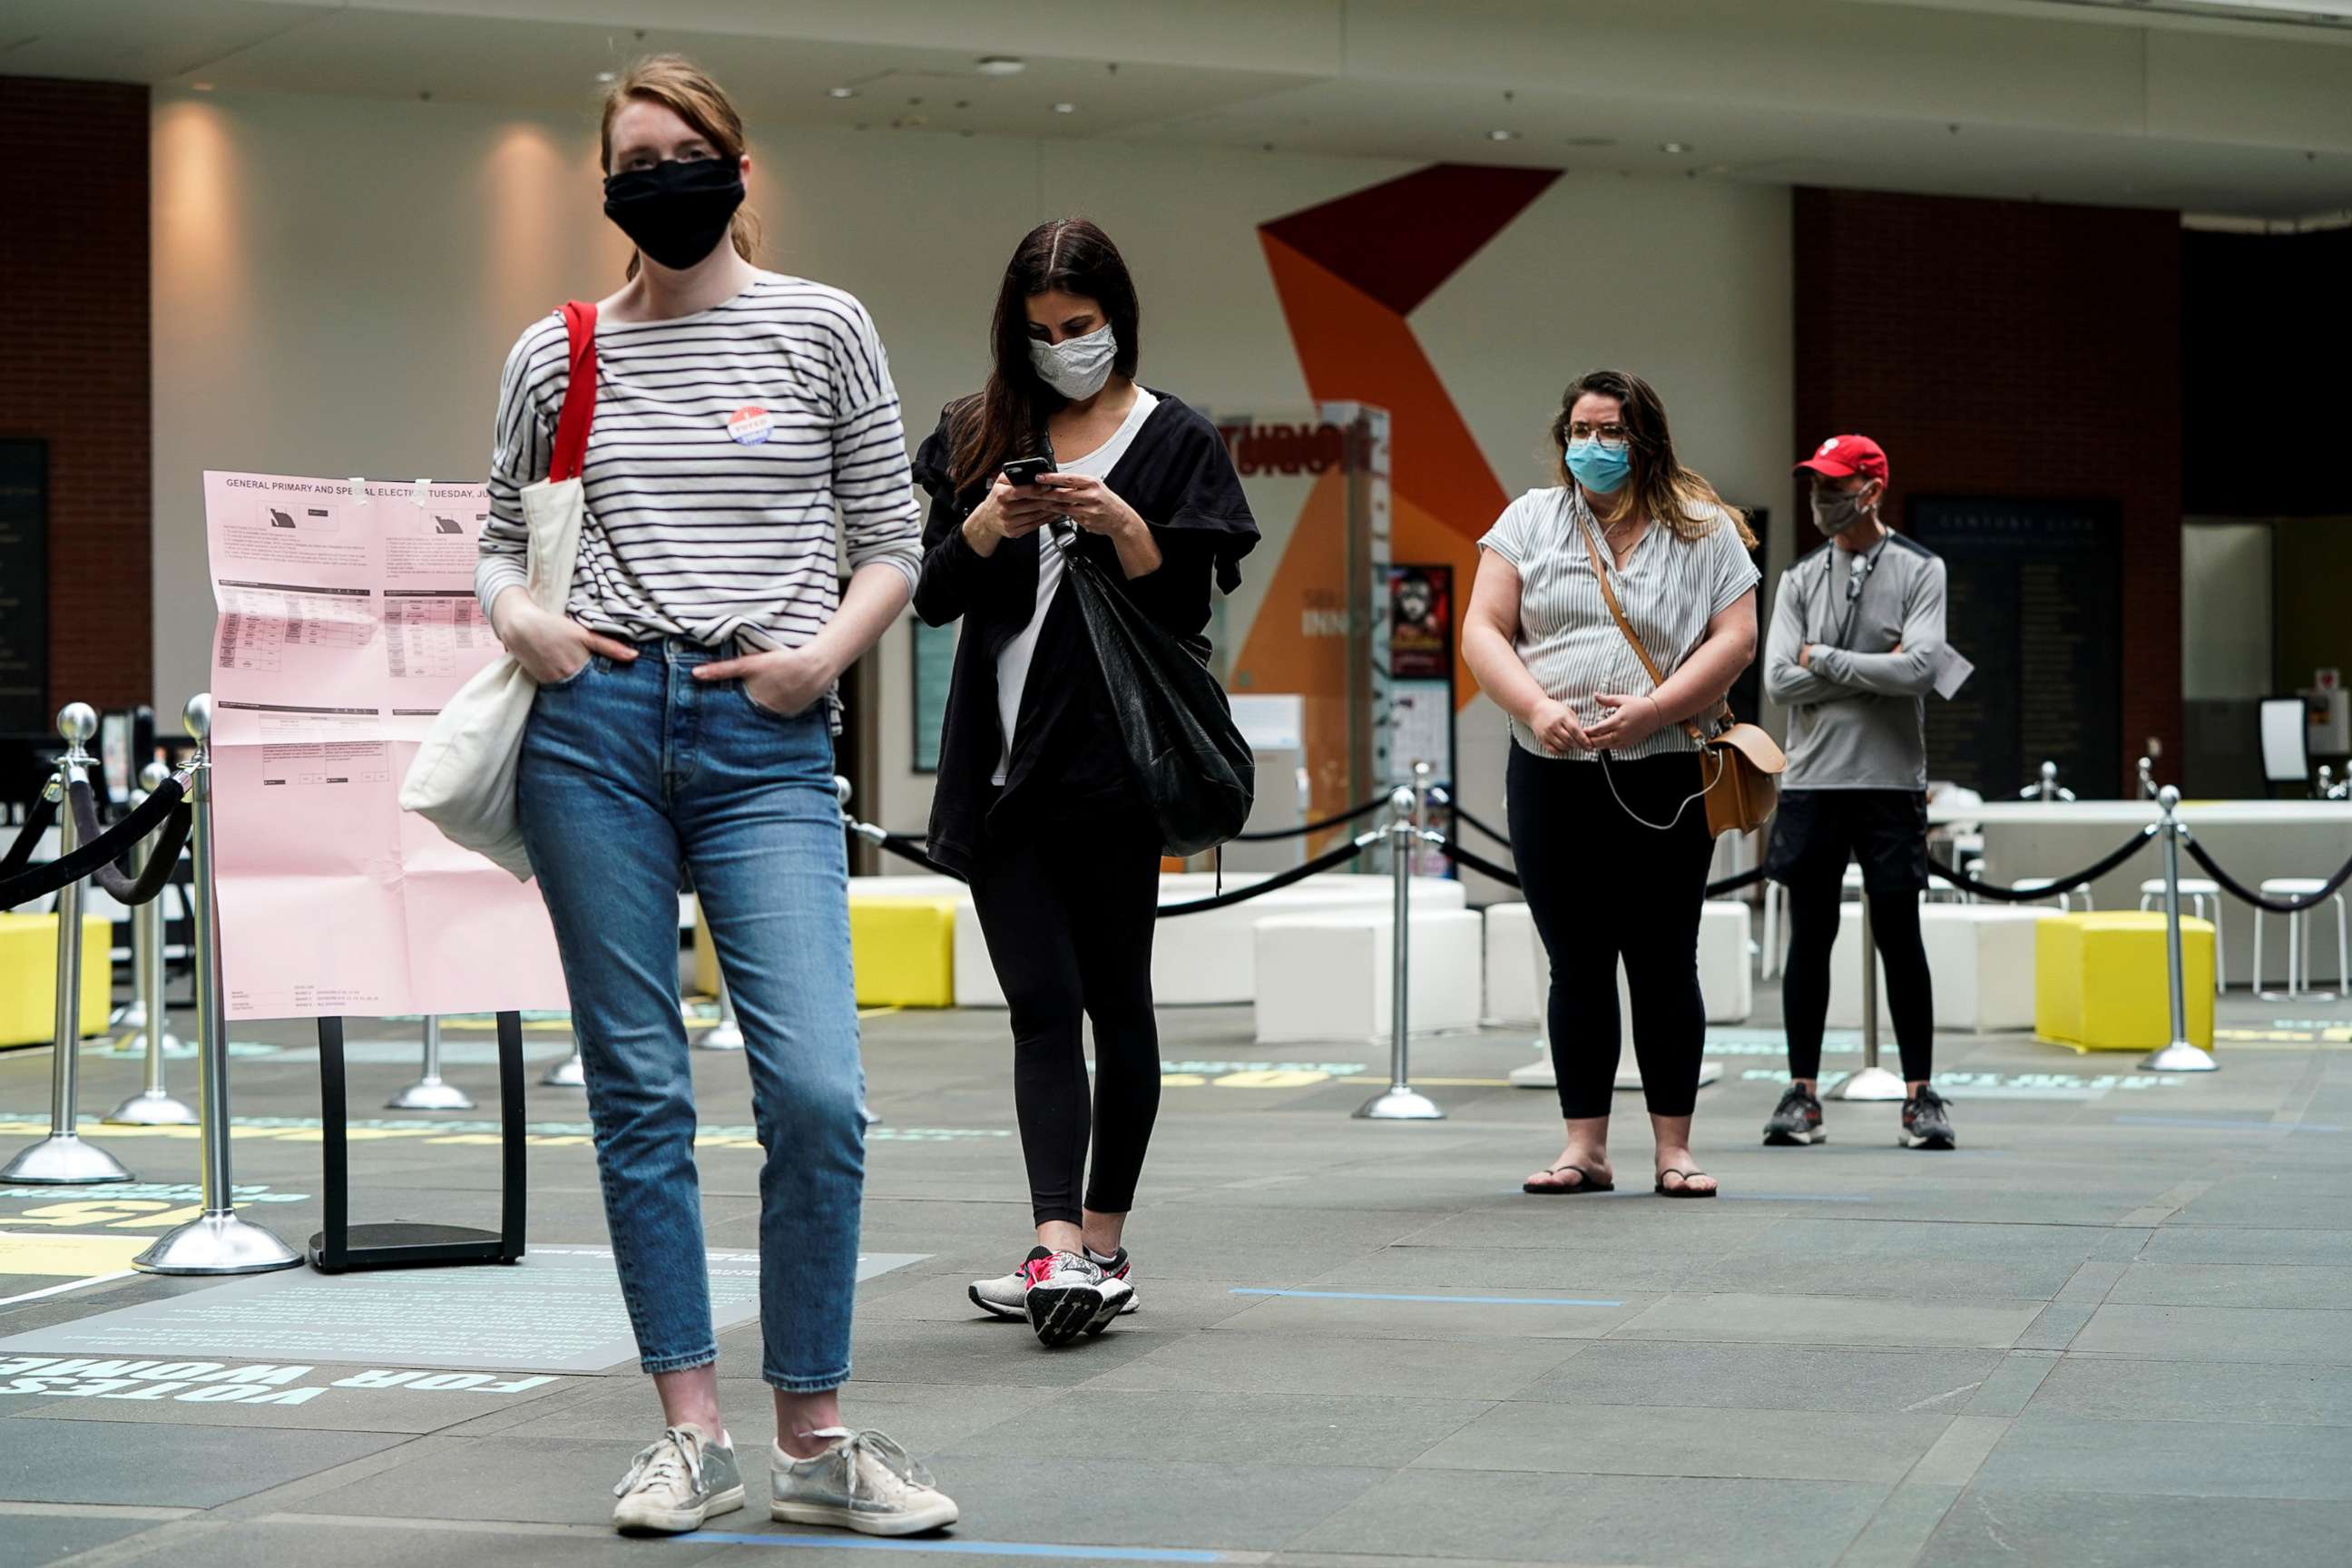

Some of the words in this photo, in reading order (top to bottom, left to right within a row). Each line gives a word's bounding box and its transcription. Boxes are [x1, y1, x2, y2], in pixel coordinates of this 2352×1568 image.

[226, 478, 270, 490] GENERAL
[271, 482, 313, 493] PRIMARY
[314, 485, 334, 495] AND
[336, 486, 376, 496] SPEAL
[377, 487, 423, 498] ELECTI
[0, 1377, 329, 1405] VOTES
[330, 1369, 561, 1394] FOR
